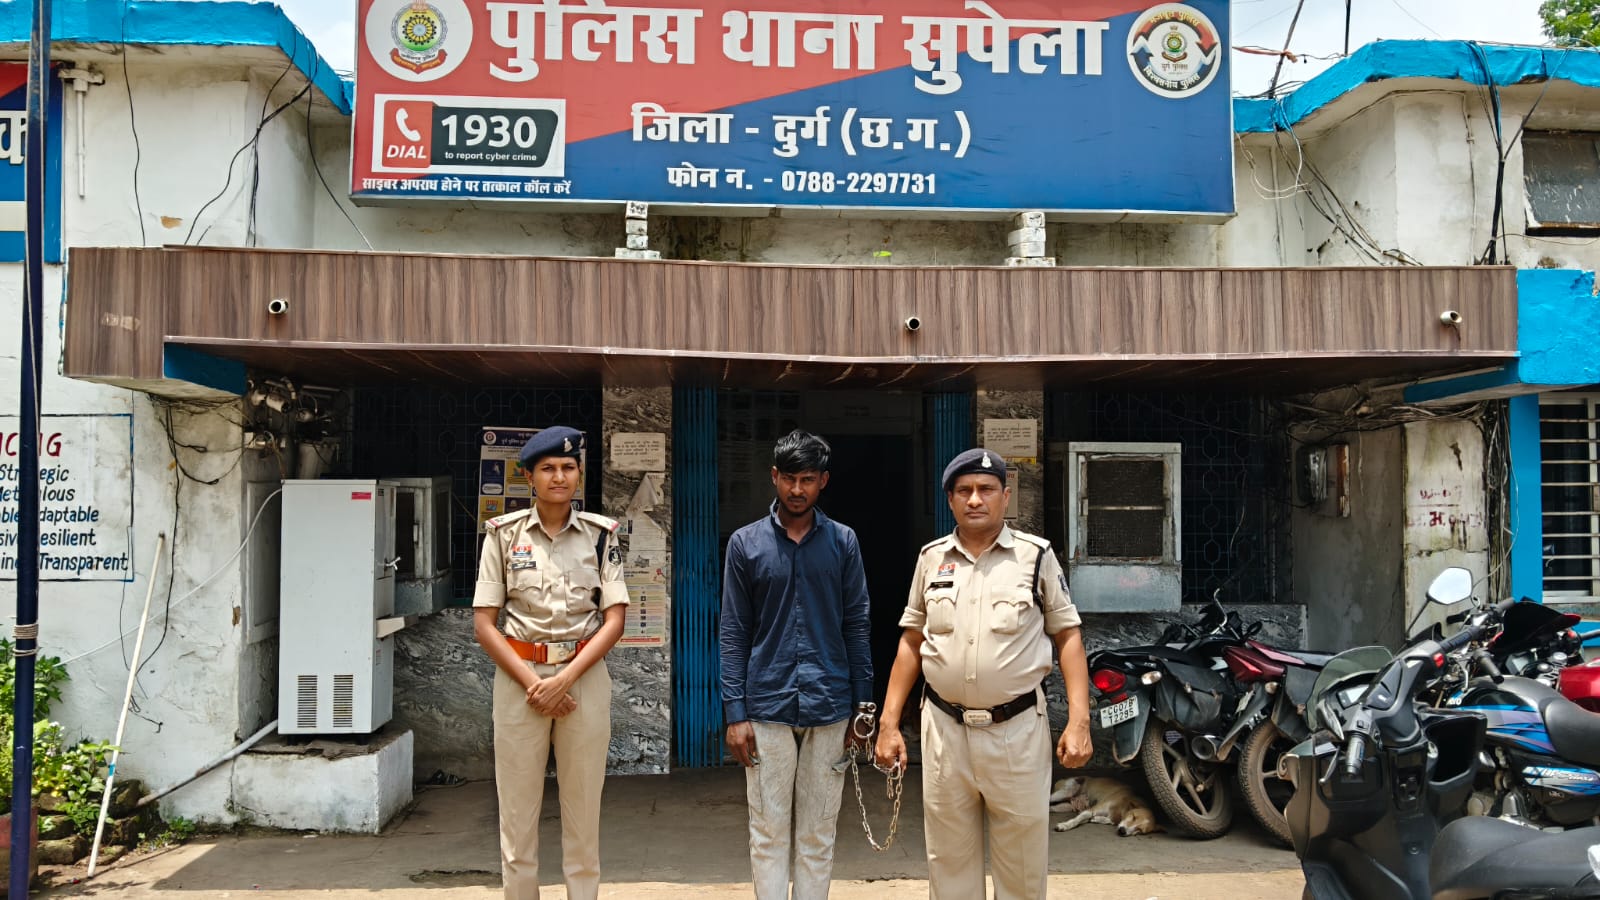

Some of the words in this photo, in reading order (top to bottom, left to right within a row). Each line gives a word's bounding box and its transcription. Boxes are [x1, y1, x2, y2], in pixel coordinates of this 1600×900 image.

[486, 0, 703, 82] पुलिस
[722, 10, 883, 70] थाना
[901, 0, 1109, 95] सुपेला
[441, 114, 537, 149] 1930
[631, 102, 734, 144] जिला
[772, 105, 831, 158] दुर्ग
[386, 145, 427, 160] DIAL
[444, 151, 454, 160] to
[456, 152, 483, 162] report
[485, 152, 510, 163] cyber
[512, 154, 537, 162] crime
[362, 177, 398, 191] साइबर
[399, 178, 439, 192] अपराध
[441, 176, 462, 192] होने
[465, 180, 481, 192] पर
[482, 181, 521, 194] तत्काल
[524, 179, 550, 194] कॉल
[553, 179, 572, 195] करें
[667, 161, 719, 189] फोन
[725, 168, 753, 190] न.
[781, 170, 936, 195] 0788-2297731
[40, 505, 99, 526] daptable
[40, 528, 97, 547] esilient
[40, 552, 128, 576] Transparent
